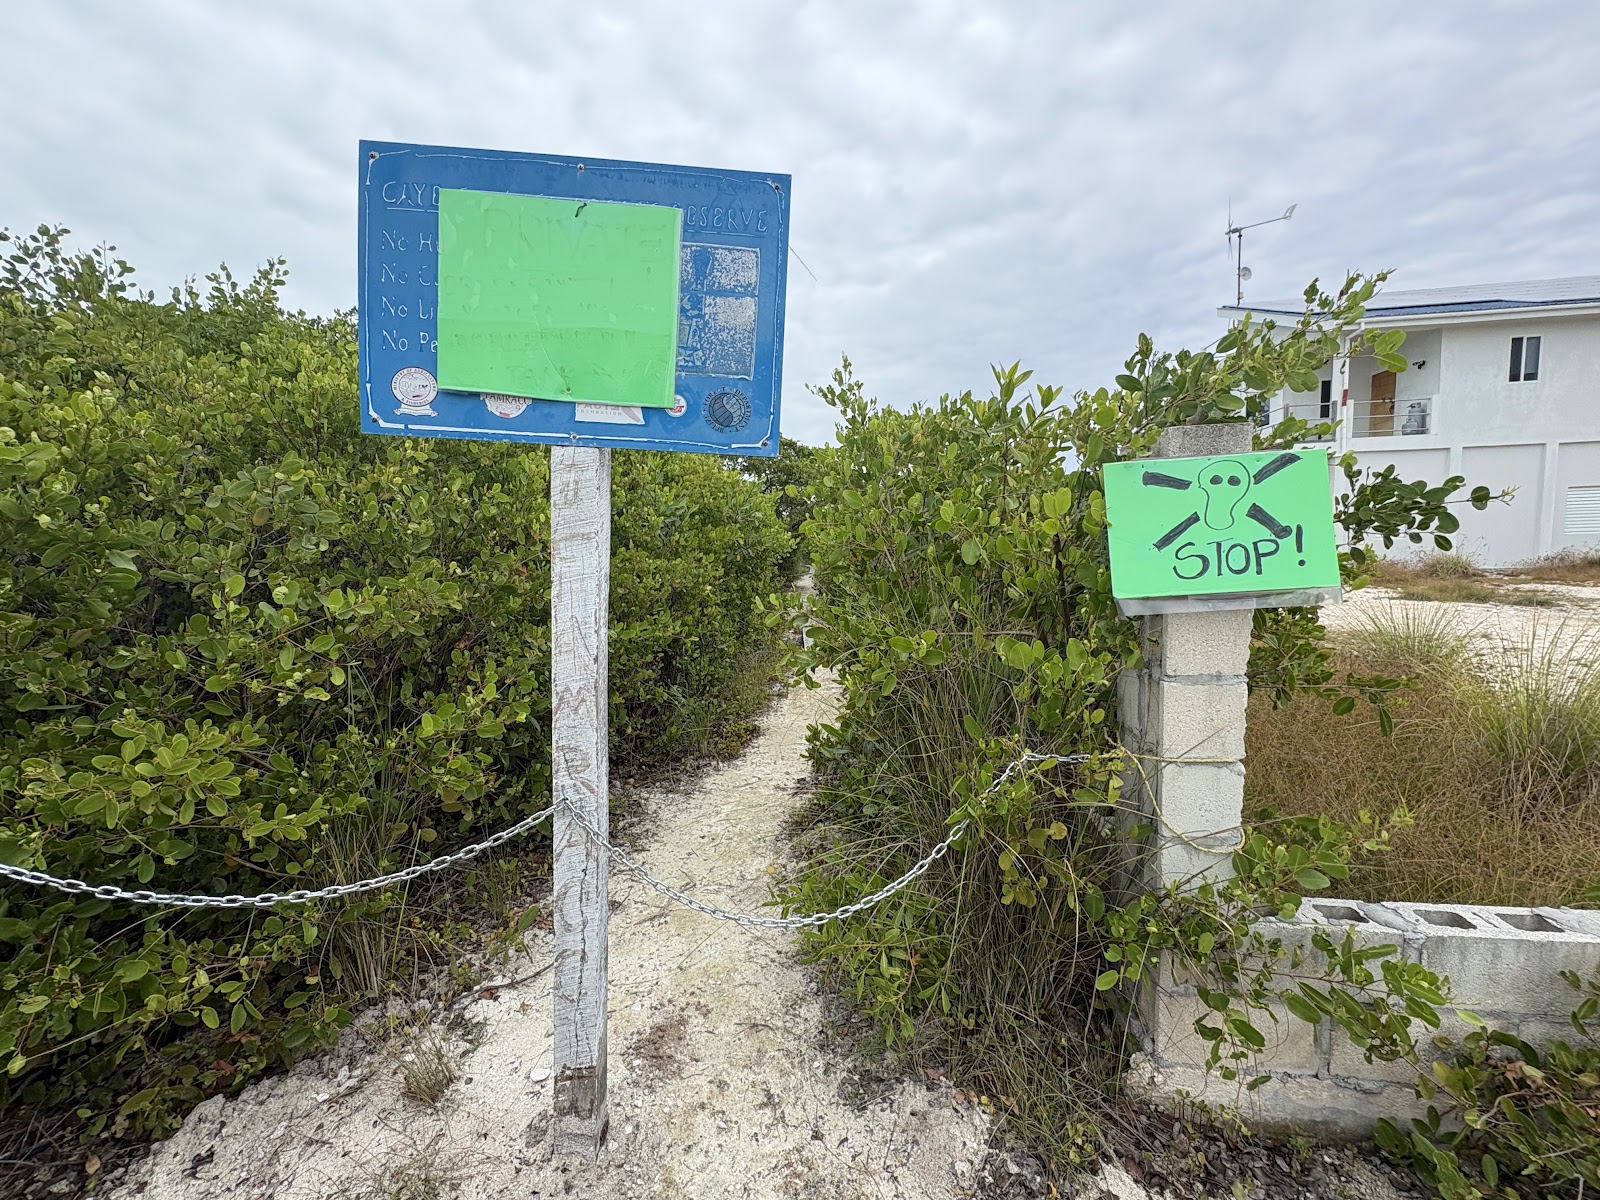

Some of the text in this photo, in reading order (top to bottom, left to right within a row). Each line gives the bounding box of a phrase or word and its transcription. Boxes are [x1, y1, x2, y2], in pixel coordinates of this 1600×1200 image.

[674, 202, 768, 232] ESERVE
[381, 229, 409, 251] No
[381, 262, 409, 285] No
[381, 296, 408, 318] No
[382, 329, 408, 351] No
